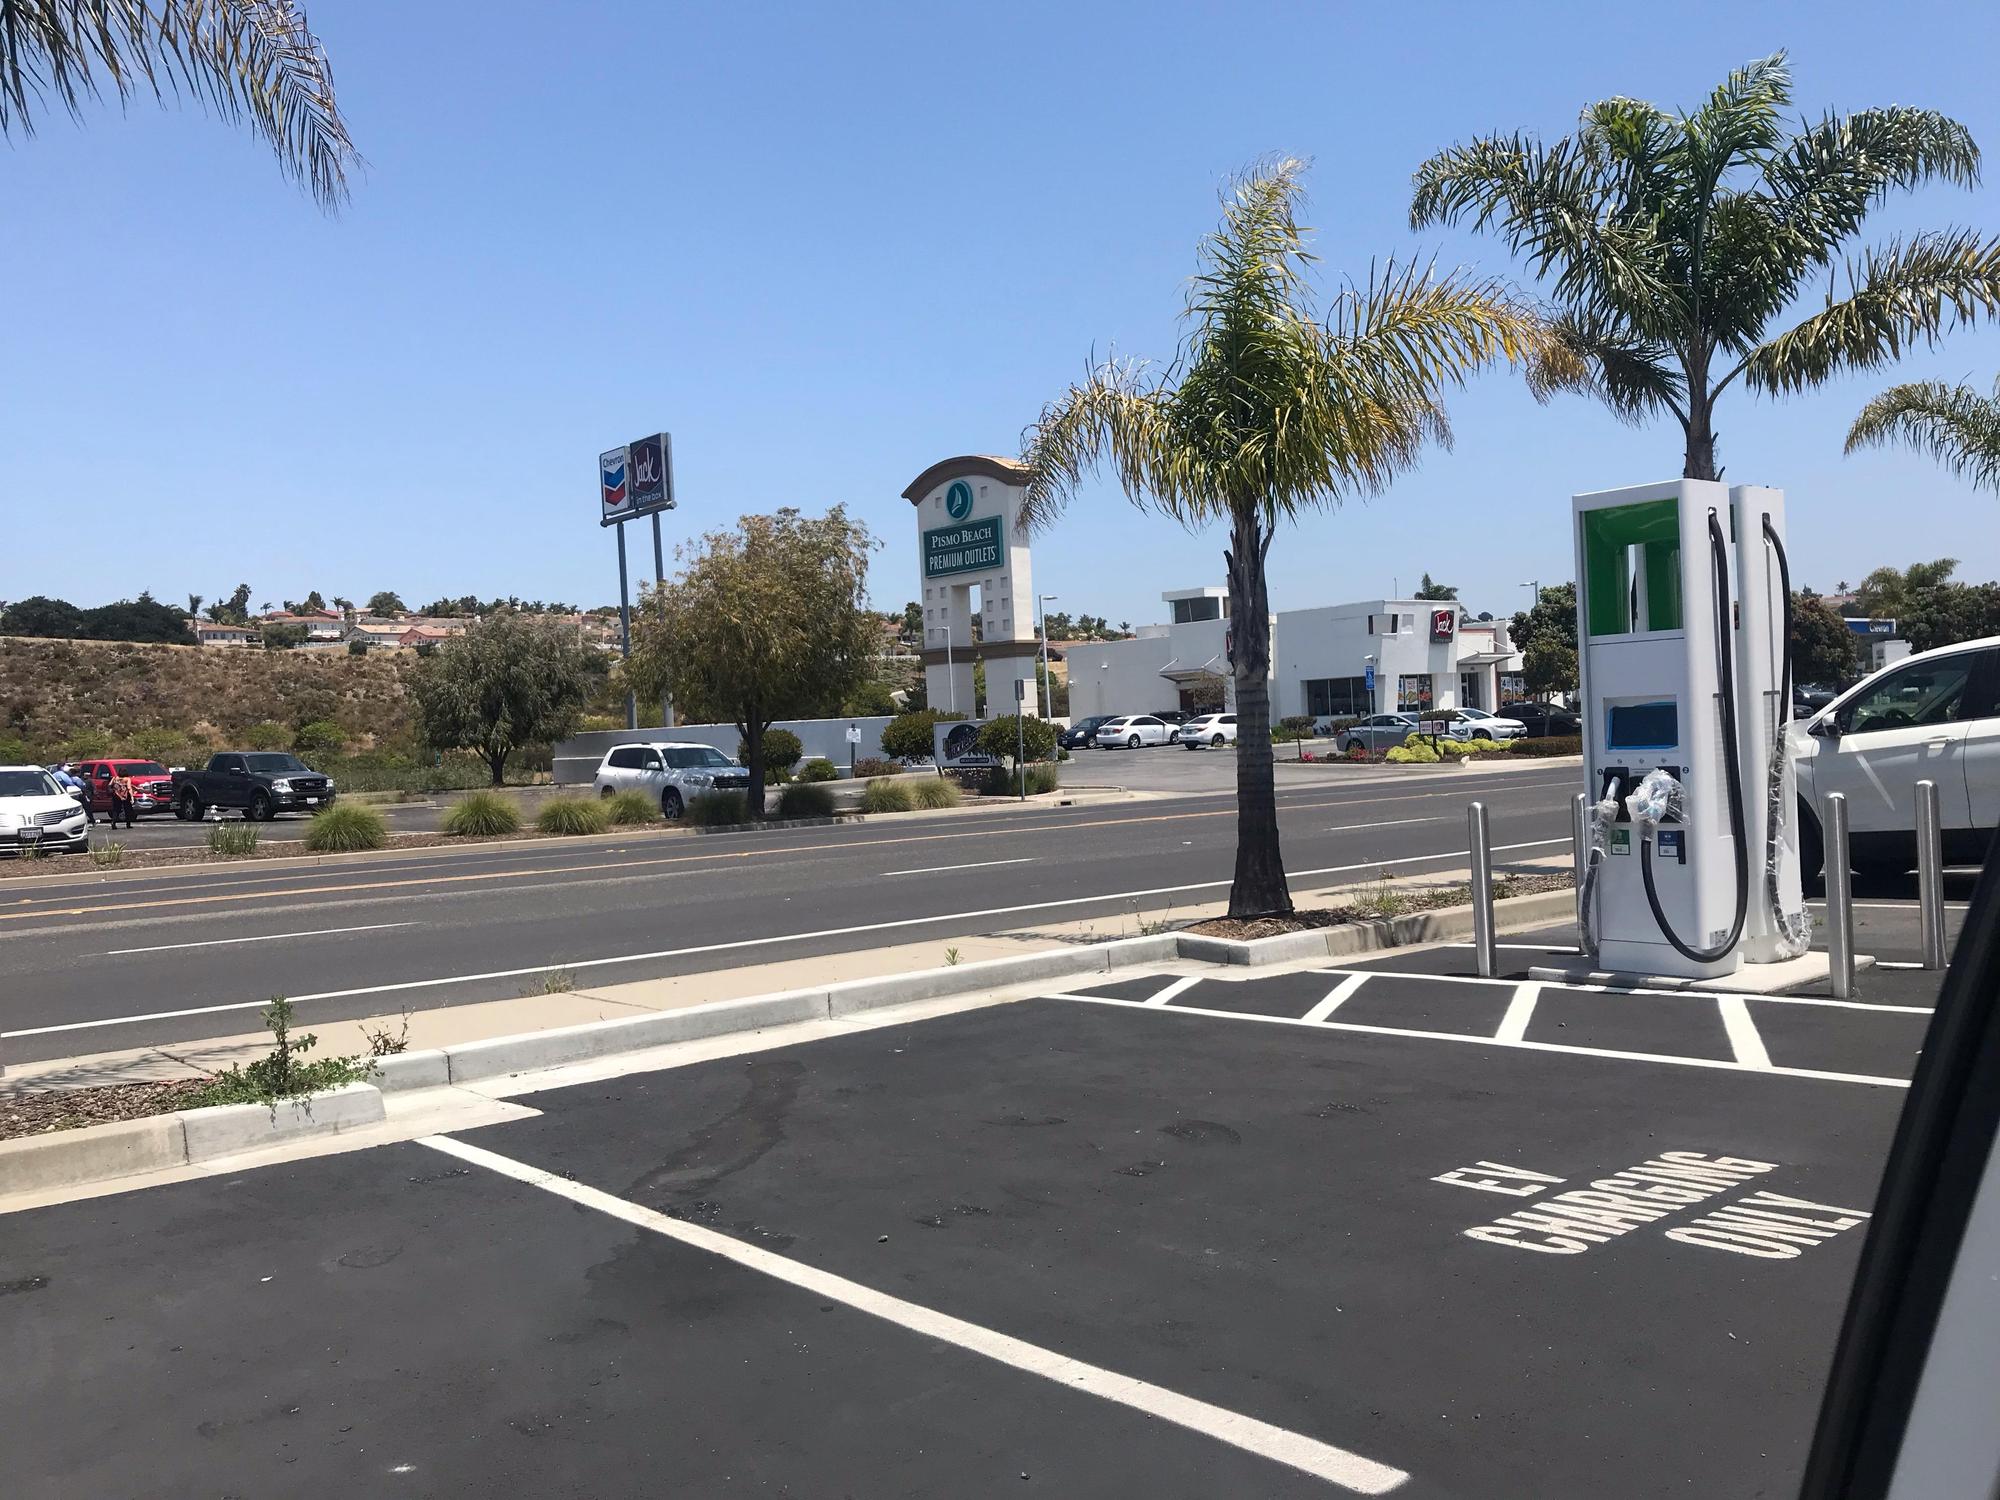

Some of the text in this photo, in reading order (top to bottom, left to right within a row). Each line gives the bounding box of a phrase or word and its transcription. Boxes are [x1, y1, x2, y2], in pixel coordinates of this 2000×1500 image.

[634, 447, 661, 487] Jack
[932, 527, 992, 548] PISMO BEACH
[929, 546, 996, 570] PREMIUM OUTLETS
[1435, 613, 1454, 634] Jack
[1430, 1161, 1567, 1196] EV
[1464, 1151, 1780, 1254] CHARGING
[1665, 1191, 1873, 1260] ONLY
